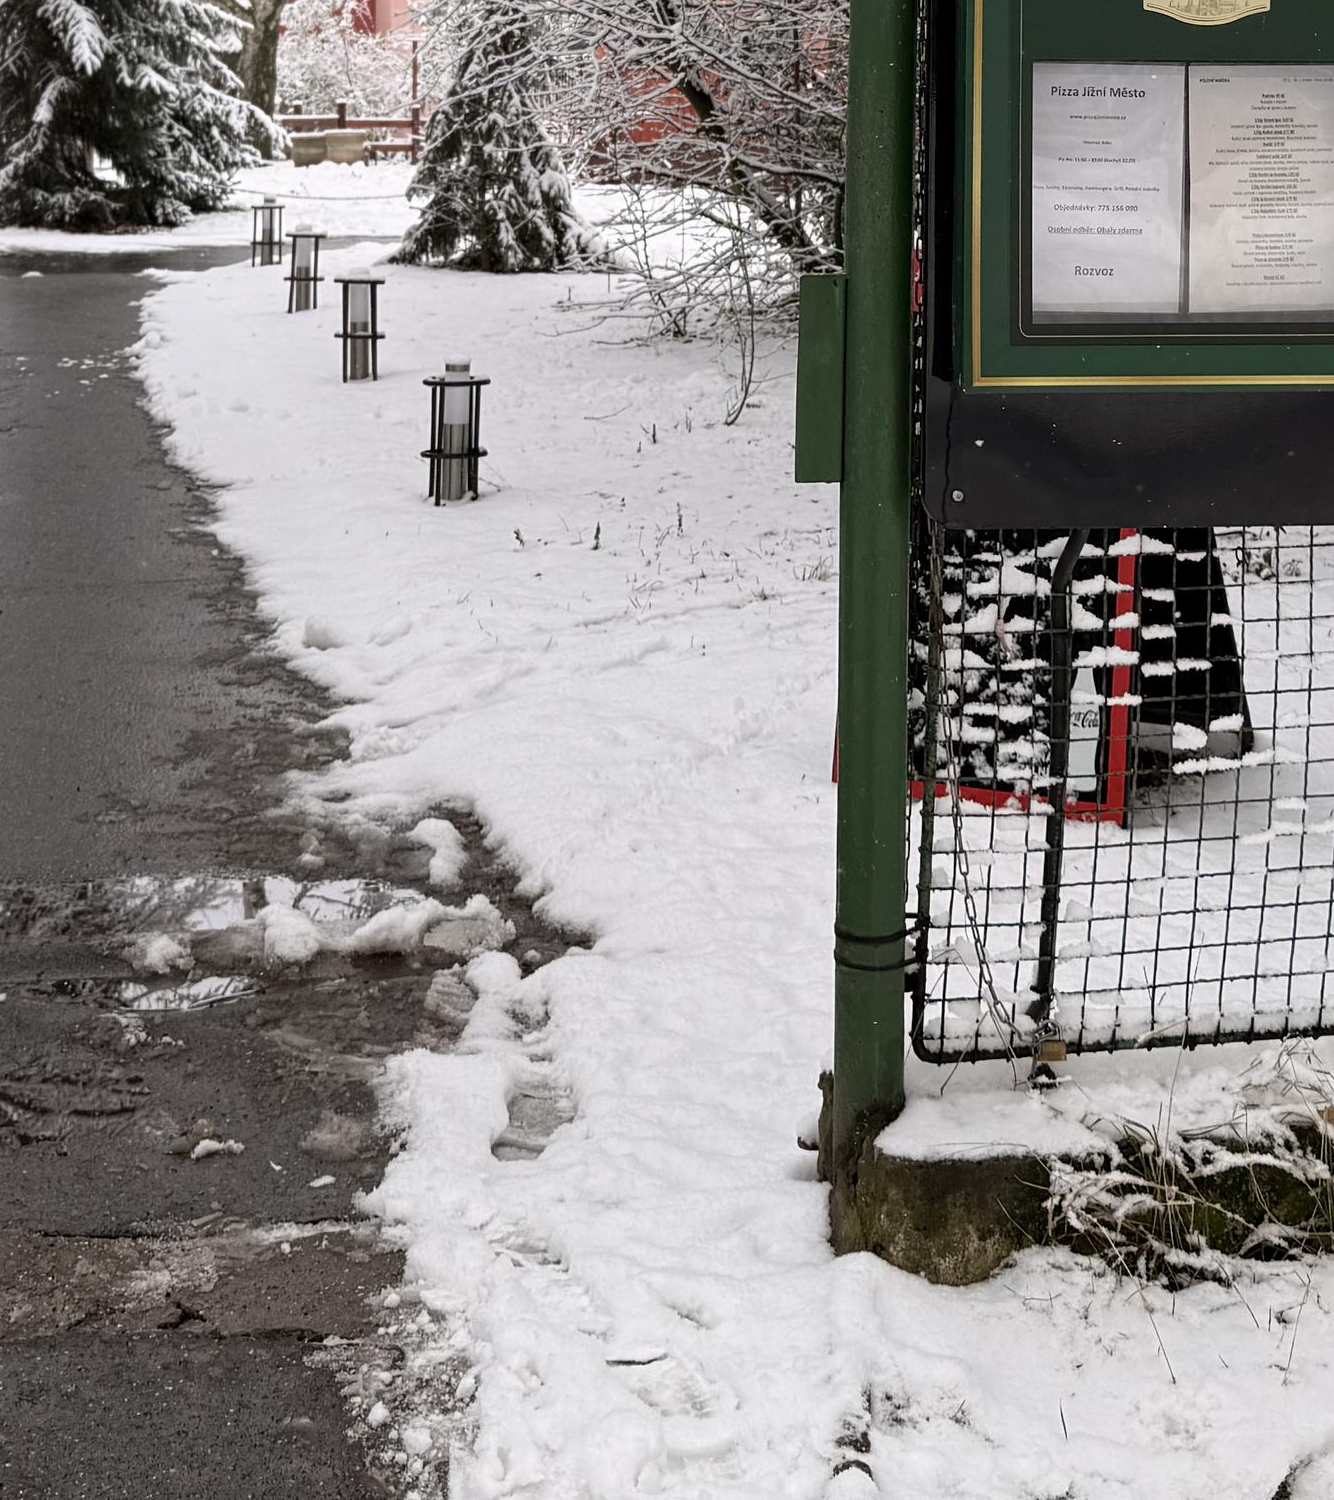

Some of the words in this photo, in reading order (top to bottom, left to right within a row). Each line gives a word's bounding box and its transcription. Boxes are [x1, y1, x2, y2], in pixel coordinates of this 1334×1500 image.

[1050, 85, 1079, 97] Pizza
[1109, 87, 1146, 98] Město
[1074, 265, 1114, 276] Rozvoz
